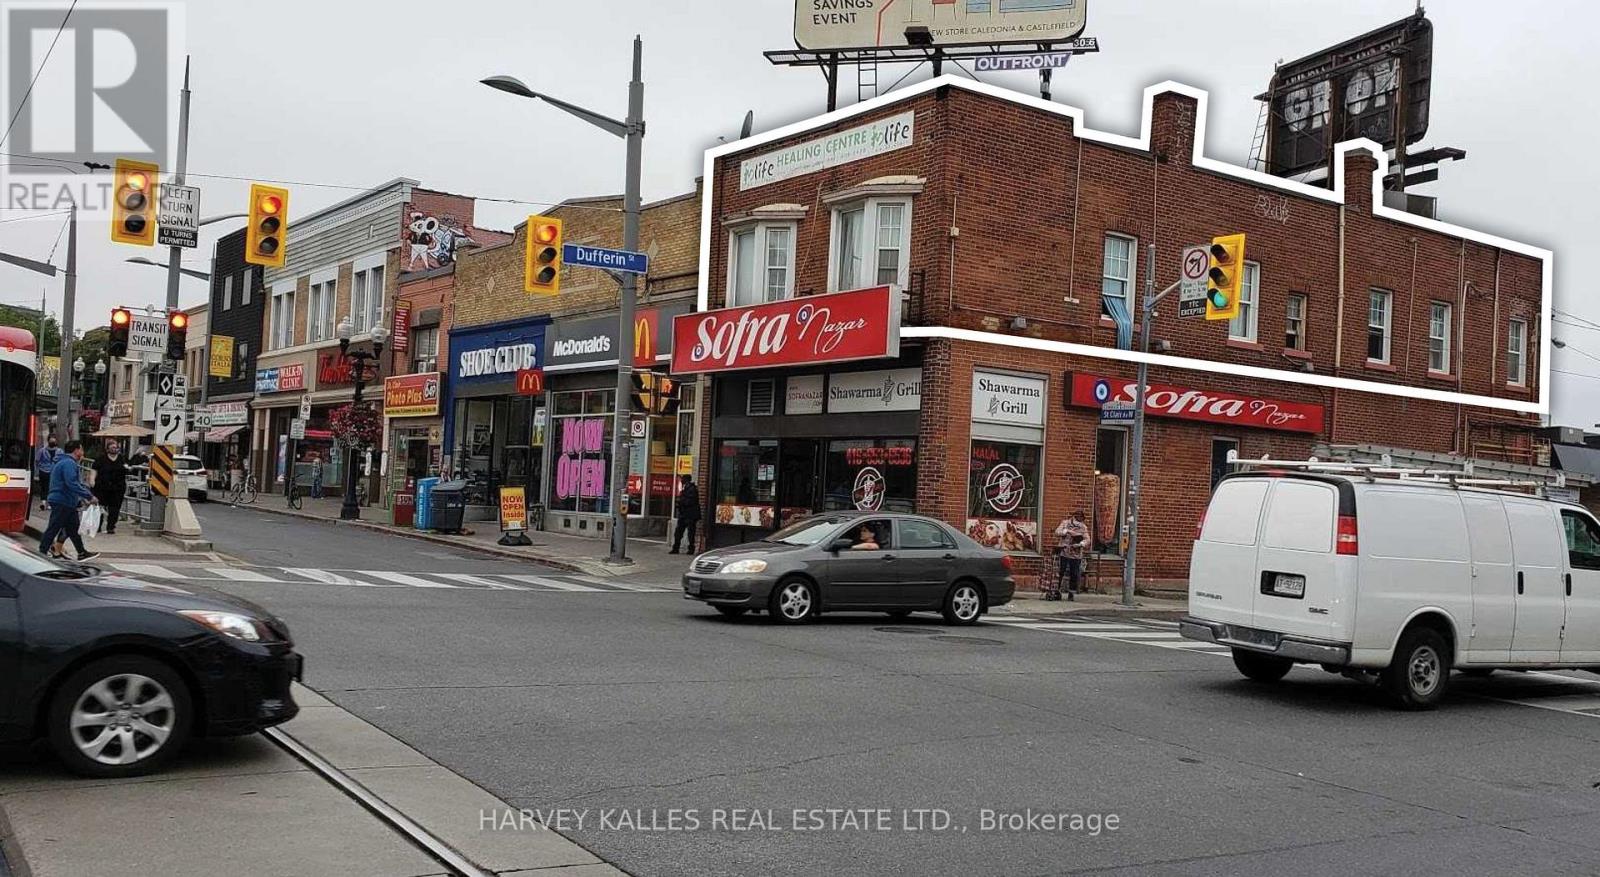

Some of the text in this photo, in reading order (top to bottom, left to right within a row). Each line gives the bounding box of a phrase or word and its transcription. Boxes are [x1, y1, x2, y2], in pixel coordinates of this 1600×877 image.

[813, 0, 873, 10] SAVINGS
[813, 12, 857, 25] EVENT
[945, 28, 969, 36] STORE
[971, 26, 1016, 34] CALEDONIA
[1026, 21, 1076, 32] CASTLEFIELD
[978, 54, 1068, 70] OUTFRONT
[777, 143, 821, 168] HEALING
[825, 129, 867, 154] CENTRE
[168, 188, 193, 200] LEFT
[167, 201, 193, 213] TURN
[161, 214, 197, 229] SIGNAL
[160, 236, 196, 247] PERMITTED
[171, 230, 193, 239] TURNS
[576, 248, 626, 265] Dufferin
[1188, 300, 1200, 308] TTC
[1180, 307, 1206, 316] EXCEPTED
[131, 320, 167, 334] TRANSIT
[131, 335, 163, 348] SIGNAL
[690, 303, 867, 367] Sofra Nazar
[552, 335, 611, 357] McDonald's
[460, 343, 537, 378] SHOE CLUB
[280, 365, 303, 378] WALK-IN
[281, 377, 301, 389] CLINIC
[978, 378, 1041, 399] Shawarma
[830, 381, 921, 400] Shawarma Grill
[387, 389, 422, 407] Photo Plus
[1113, 383, 1246, 417] Sofra
[1001, 400, 1028, 415] Grill
[196, 416, 211, 425] 40
[562, 417, 605, 455] NOW
[556, 453, 606, 500] OPEN
[502, 495, 524, 503] NOW
[502, 503, 524, 511] OPEN
